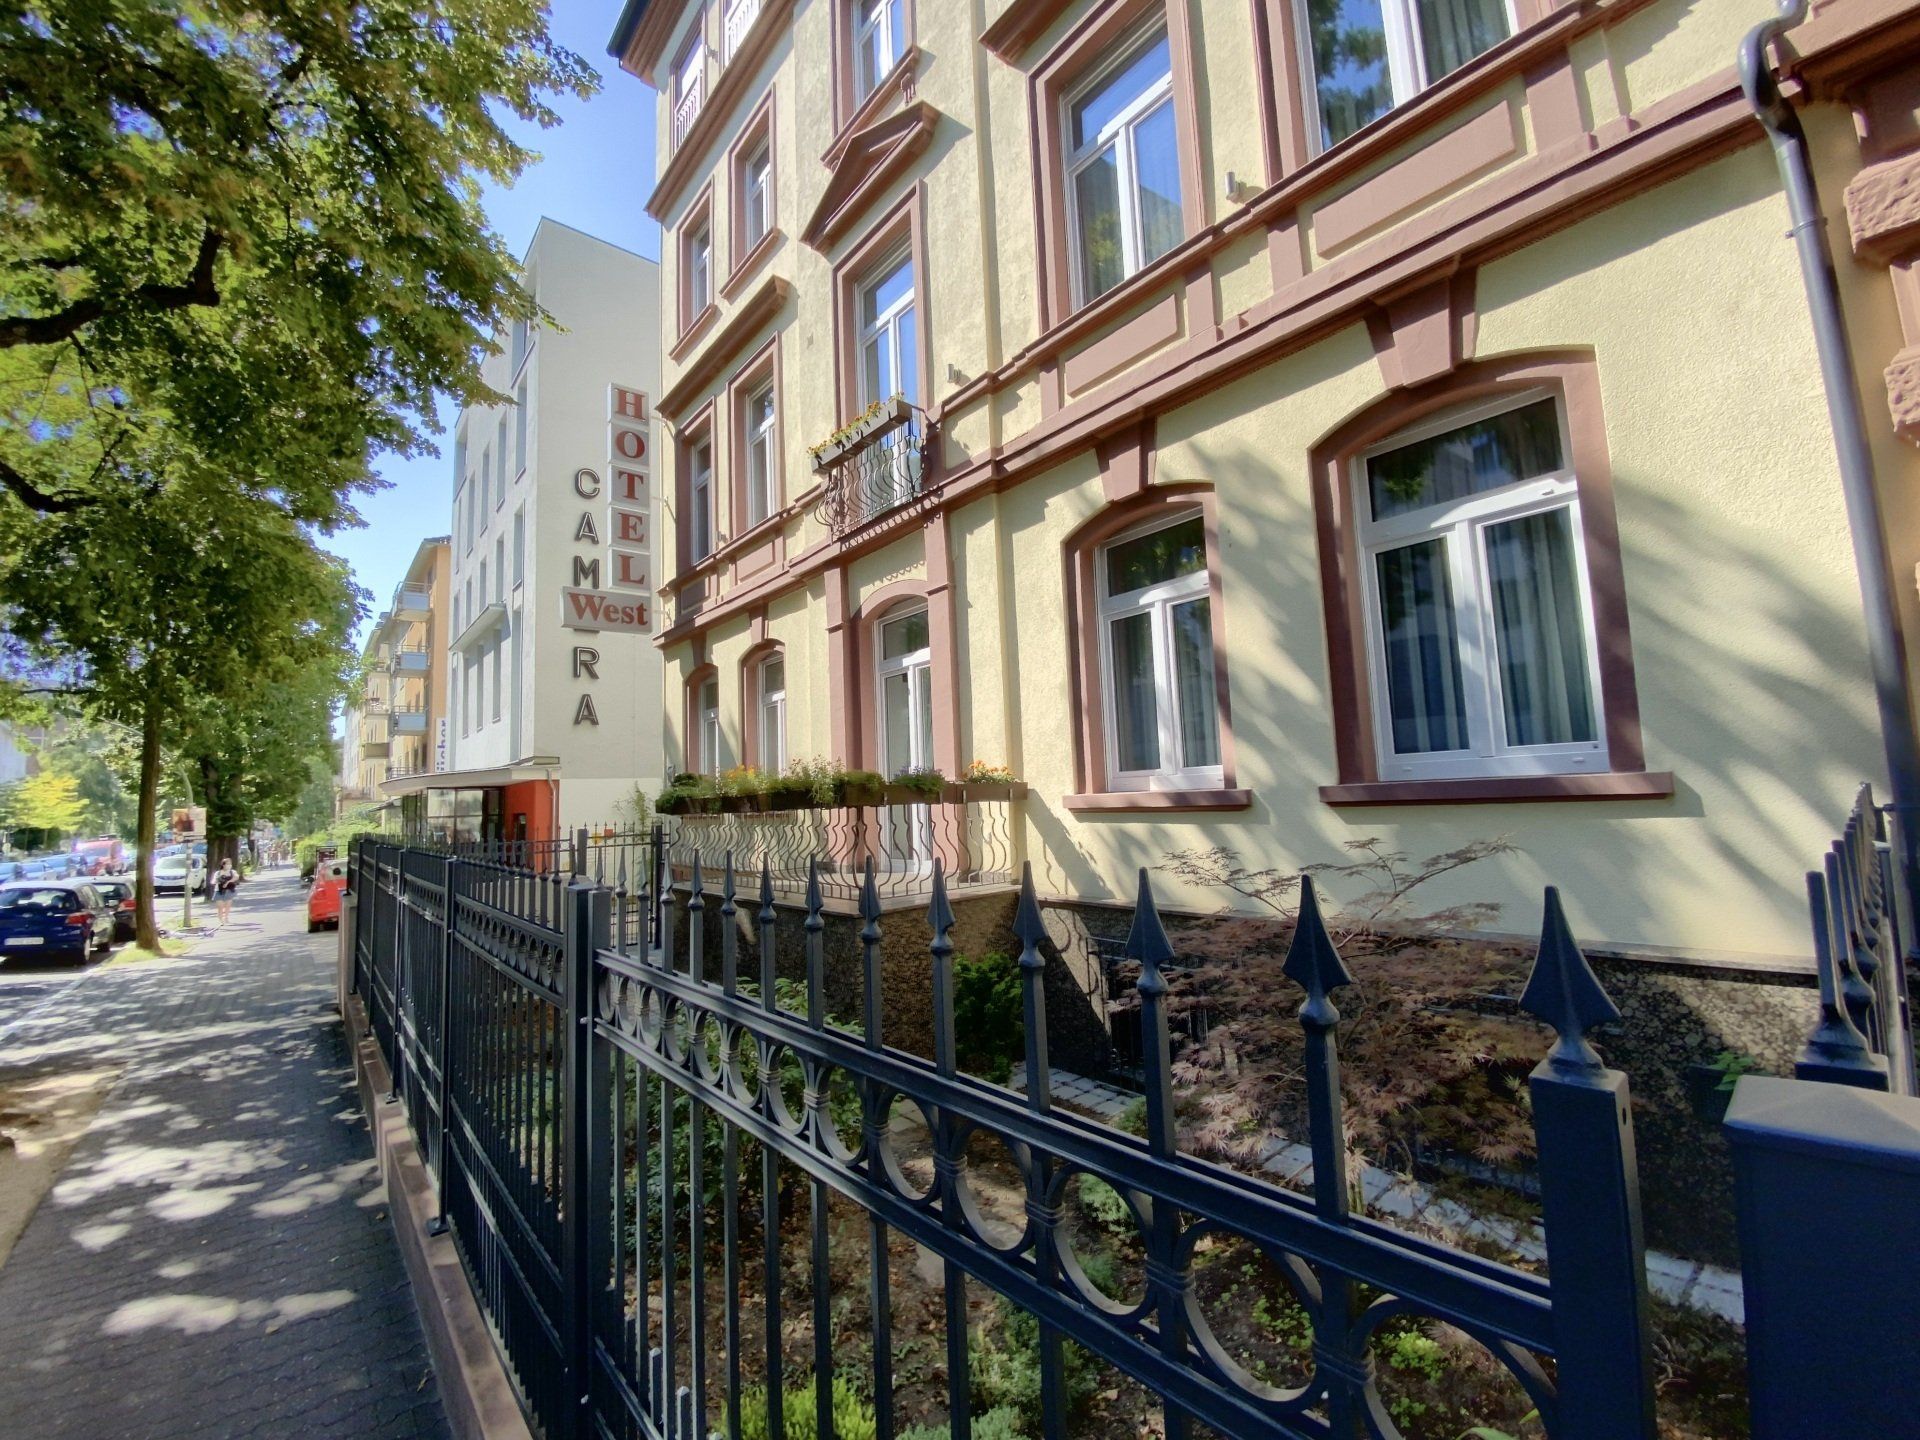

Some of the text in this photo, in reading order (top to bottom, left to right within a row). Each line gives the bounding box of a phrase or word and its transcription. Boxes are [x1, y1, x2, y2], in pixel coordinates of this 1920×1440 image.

[614, 387, 646, 585] HOTEL
[567, 591, 649, 626] West
[573, 467, 600, 726] CAMRA
